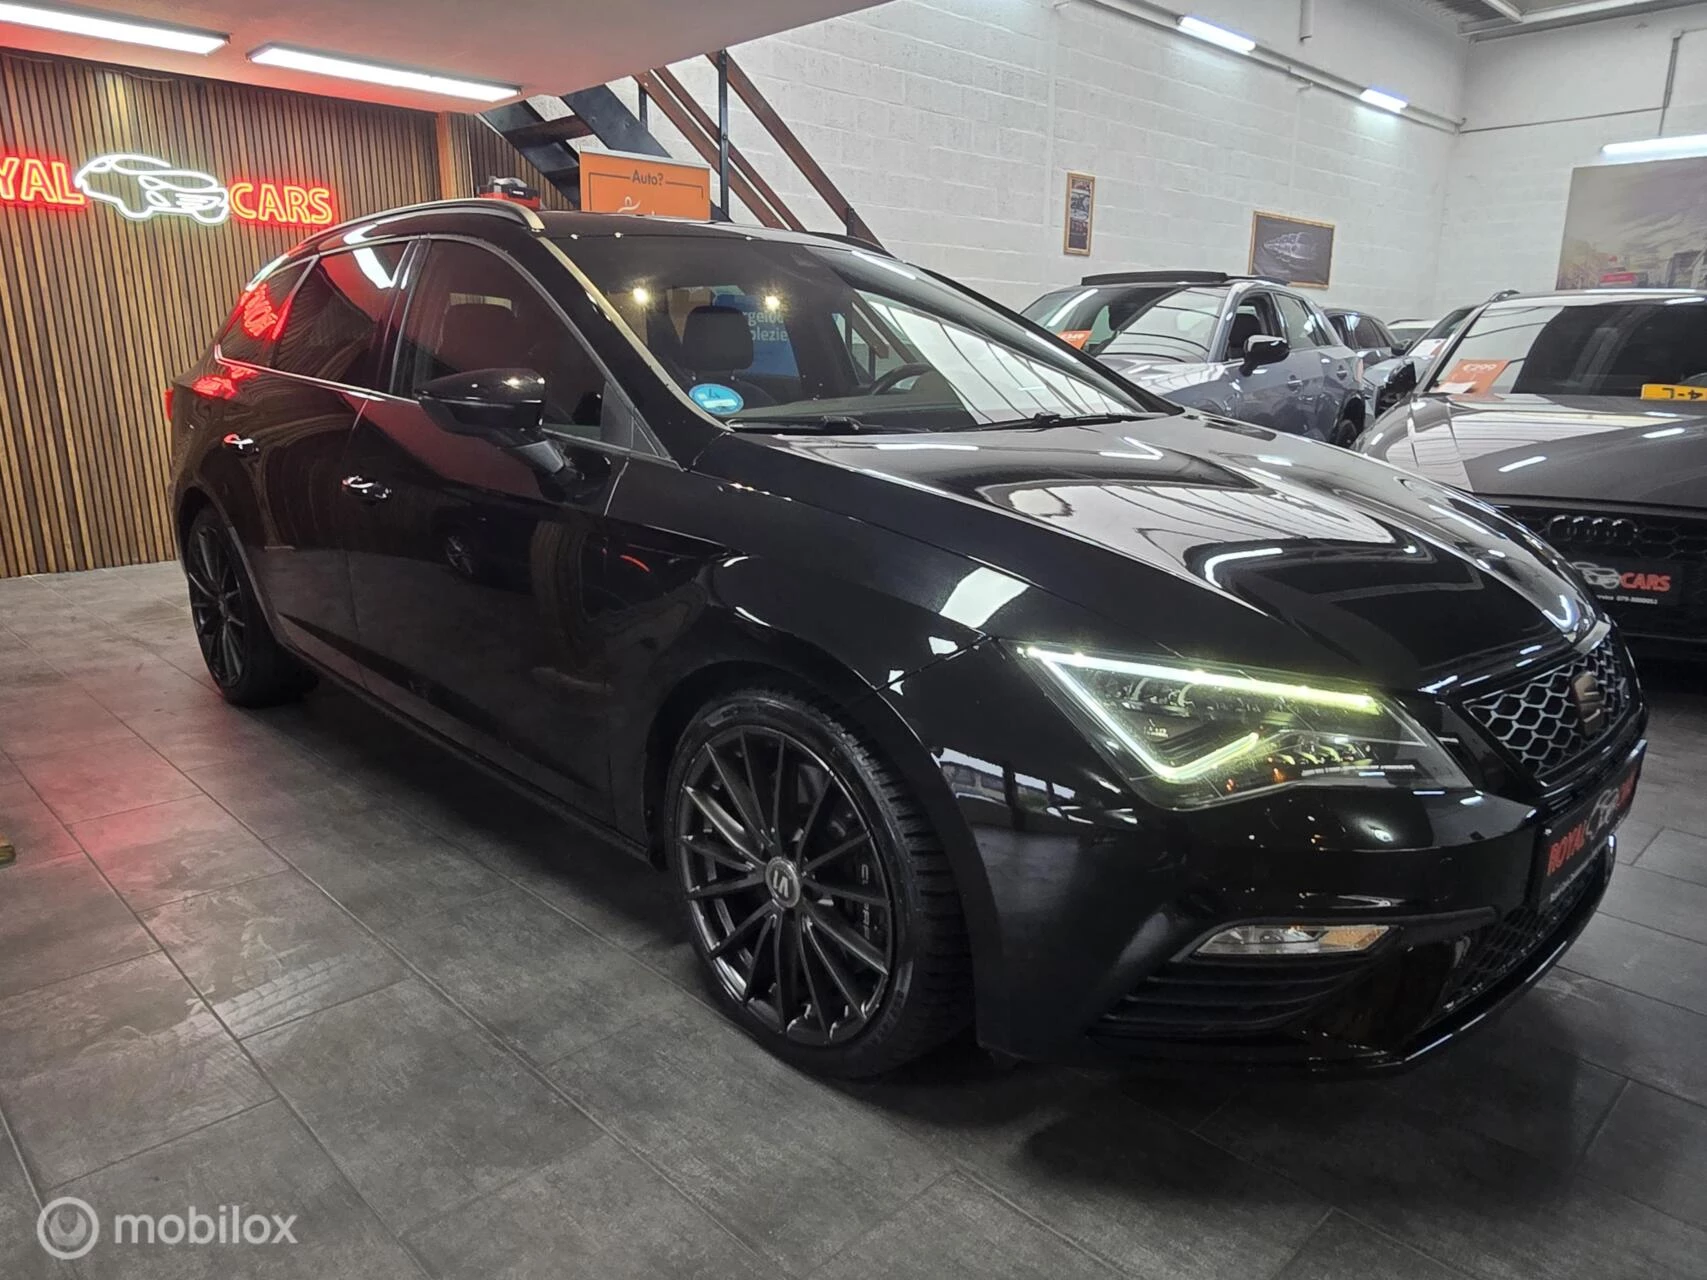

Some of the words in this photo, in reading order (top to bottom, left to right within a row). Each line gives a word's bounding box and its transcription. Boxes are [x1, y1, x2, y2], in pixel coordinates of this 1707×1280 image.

[632, 170, 664, 186] Auto?
[229, 181, 334, 225] CARS
[1620, 572, 1671, 591] CARS
